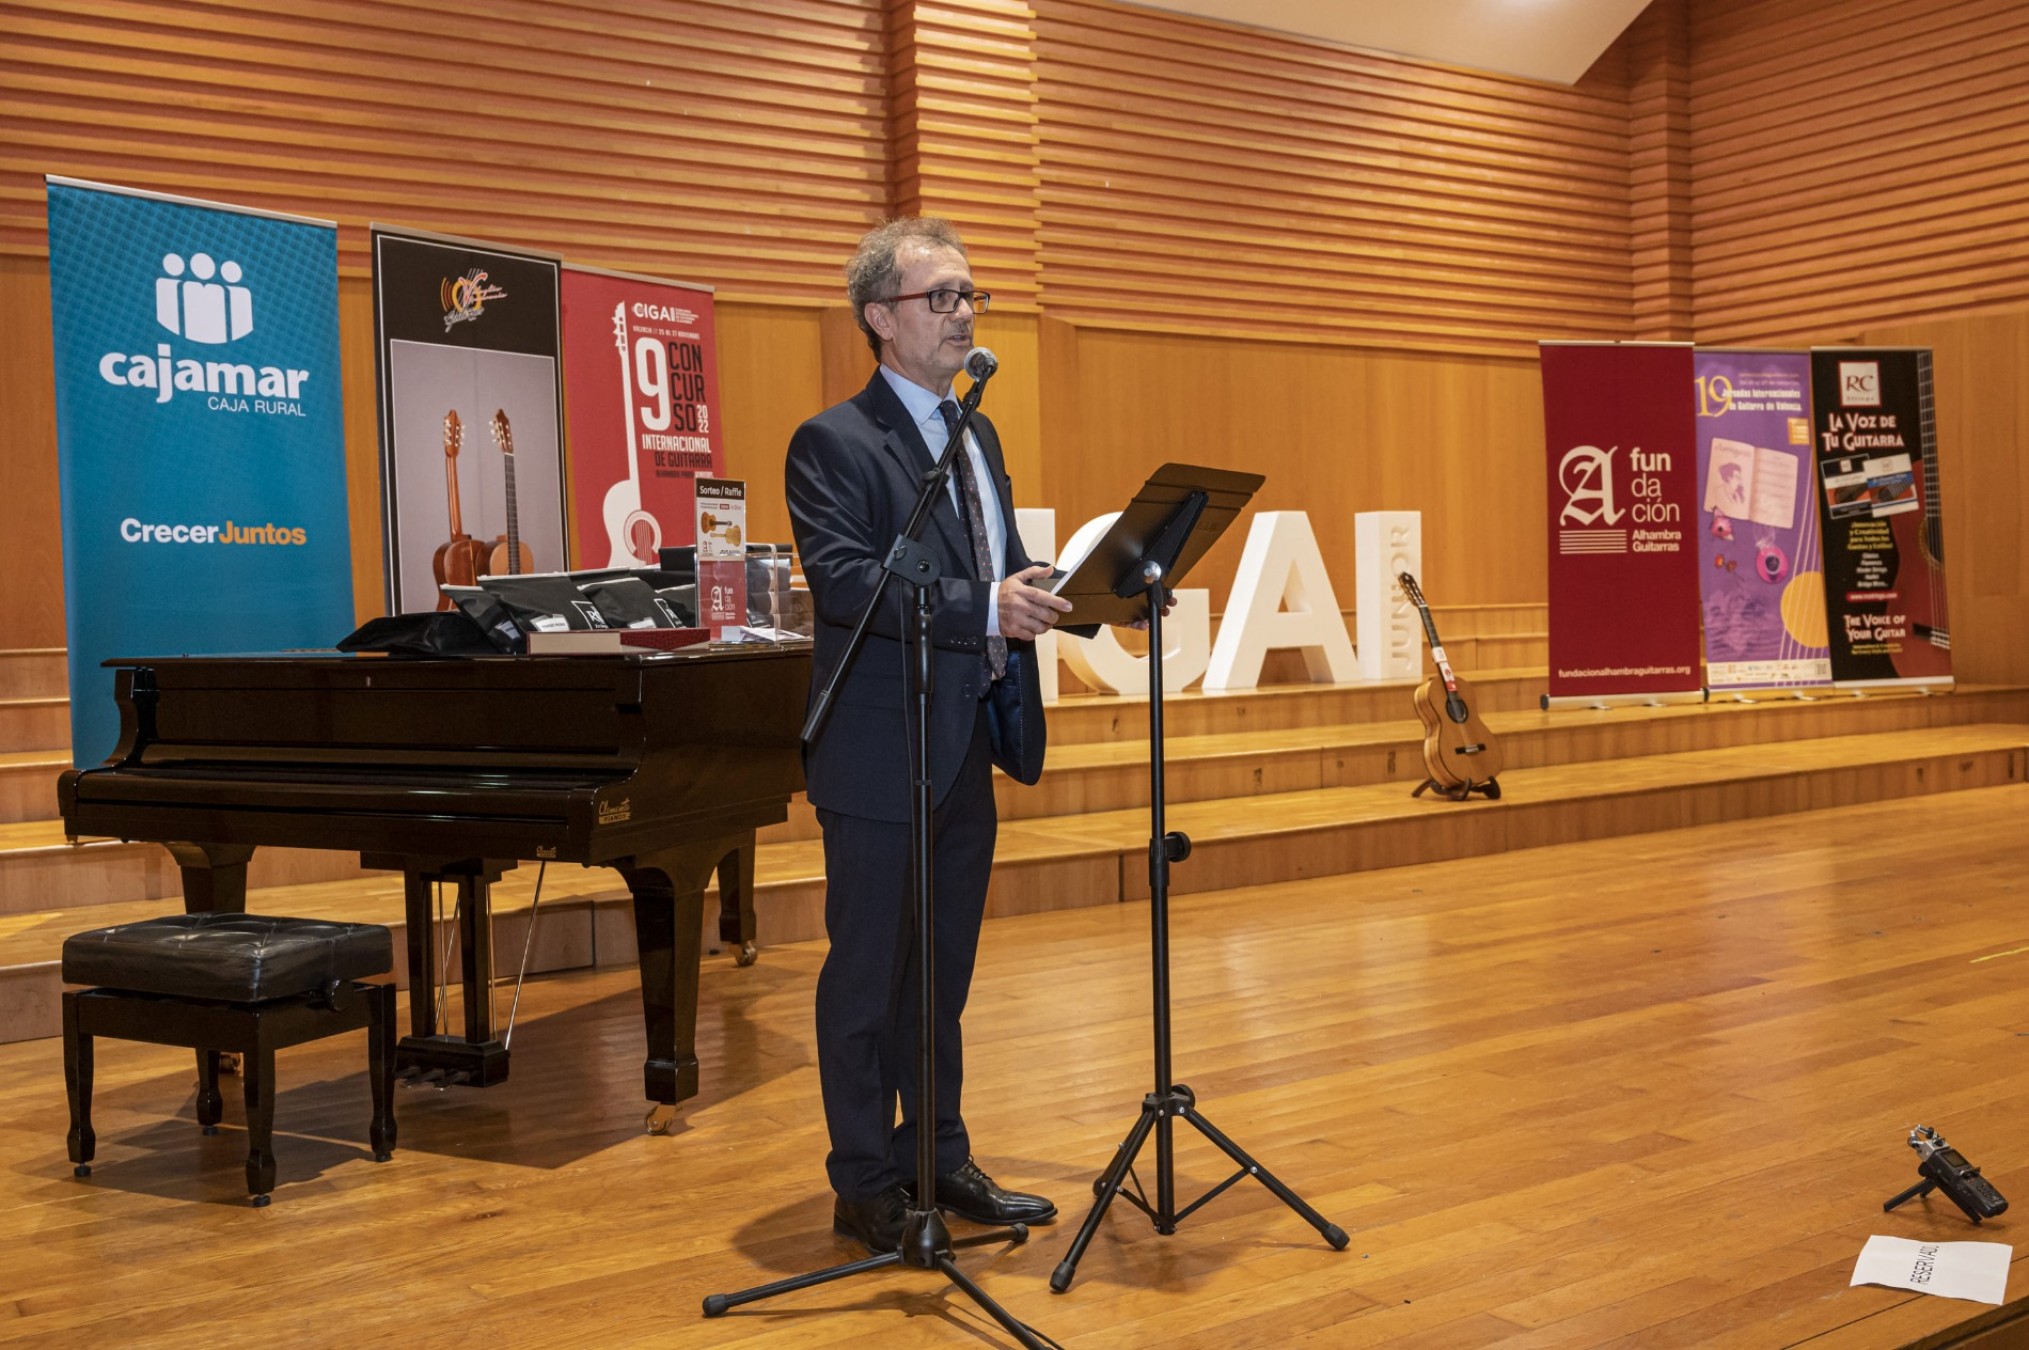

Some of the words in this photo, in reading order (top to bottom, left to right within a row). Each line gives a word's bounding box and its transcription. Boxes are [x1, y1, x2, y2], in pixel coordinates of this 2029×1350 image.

[632, 302, 676, 322] CIGAI
[668, 341, 703, 373] CON
[99, 343, 310, 404] cajamar
[1845, 374, 1874, 393] RC
[635, 337, 671, 431] 9
[670, 372, 706, 403] CUR
[208, 396, 249, 412] CAJA
[255, 400, 306, 416] RURAL
[1694, 375, 1733, 418] 19
[673, 402, 697, 432] SO
[696, 404, 708, 420] 20
[698, 420, 709, 433] 22
[642, 434, 712, 453] INTERNACIONAL
[655, 451, 666, 467] DE
[668, 452, 712, 468] GUITARRA
[1630, 447, 1671, 472] fun
[699, 485, 720, 495] Sorteo
[724, 487, 742, 496] Raffle
[1631, 472, 1662, 498] da
[1632, 497, 1680, 522] ción
[1632, 529, 1681, 540] Alhambra
[1632, 541, 1680, 552] Guitarras
[1558, 665, 1691, 678] fundacionalhambraguitarras.org
